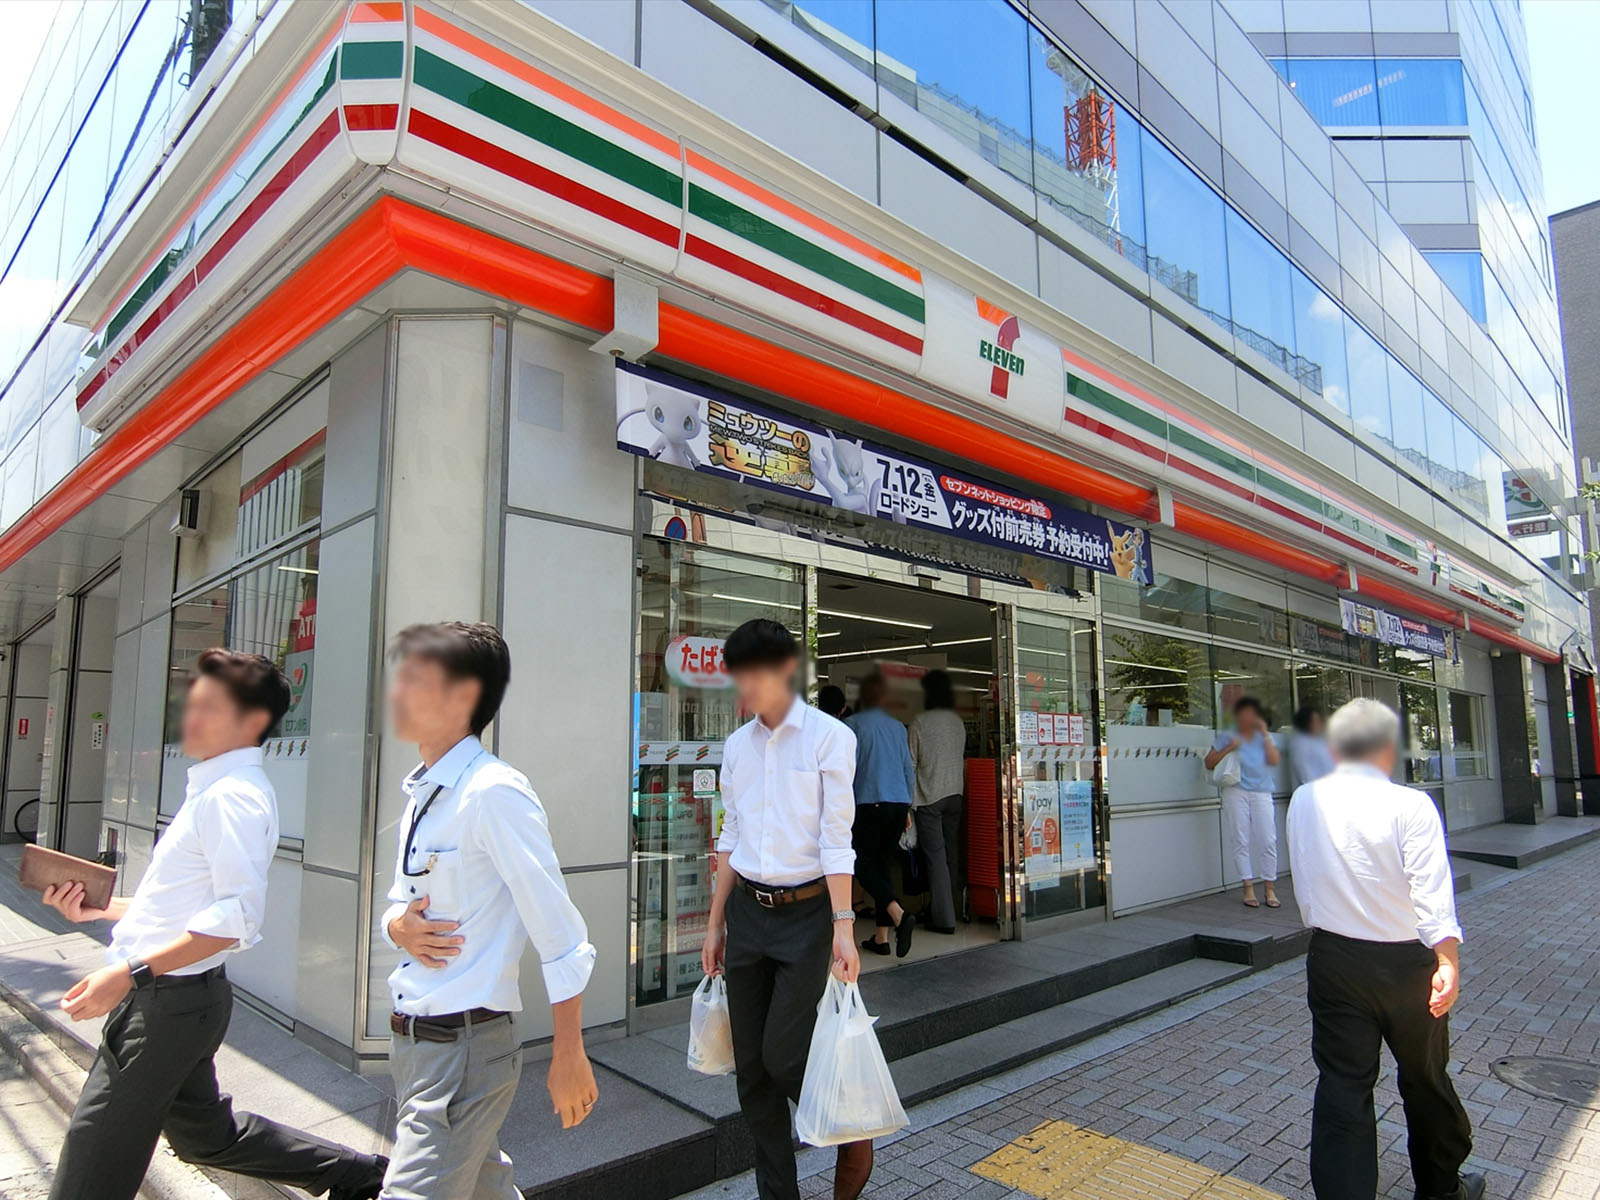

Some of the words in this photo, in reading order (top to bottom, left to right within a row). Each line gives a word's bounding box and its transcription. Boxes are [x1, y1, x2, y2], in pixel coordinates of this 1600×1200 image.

[979, 339, 1025, 377] ELEVEN
[708, 400, 811, 453] ミュウツーの
[876, 458, 923, 499] 7.12
[945, 477, 1048, 518] セブンネットショッピング限定
[880, 492, 938, 519] ロードショー
[951, 499, 1046, 549] グッズ付前売券
[298, 613, 316, 640] AT
